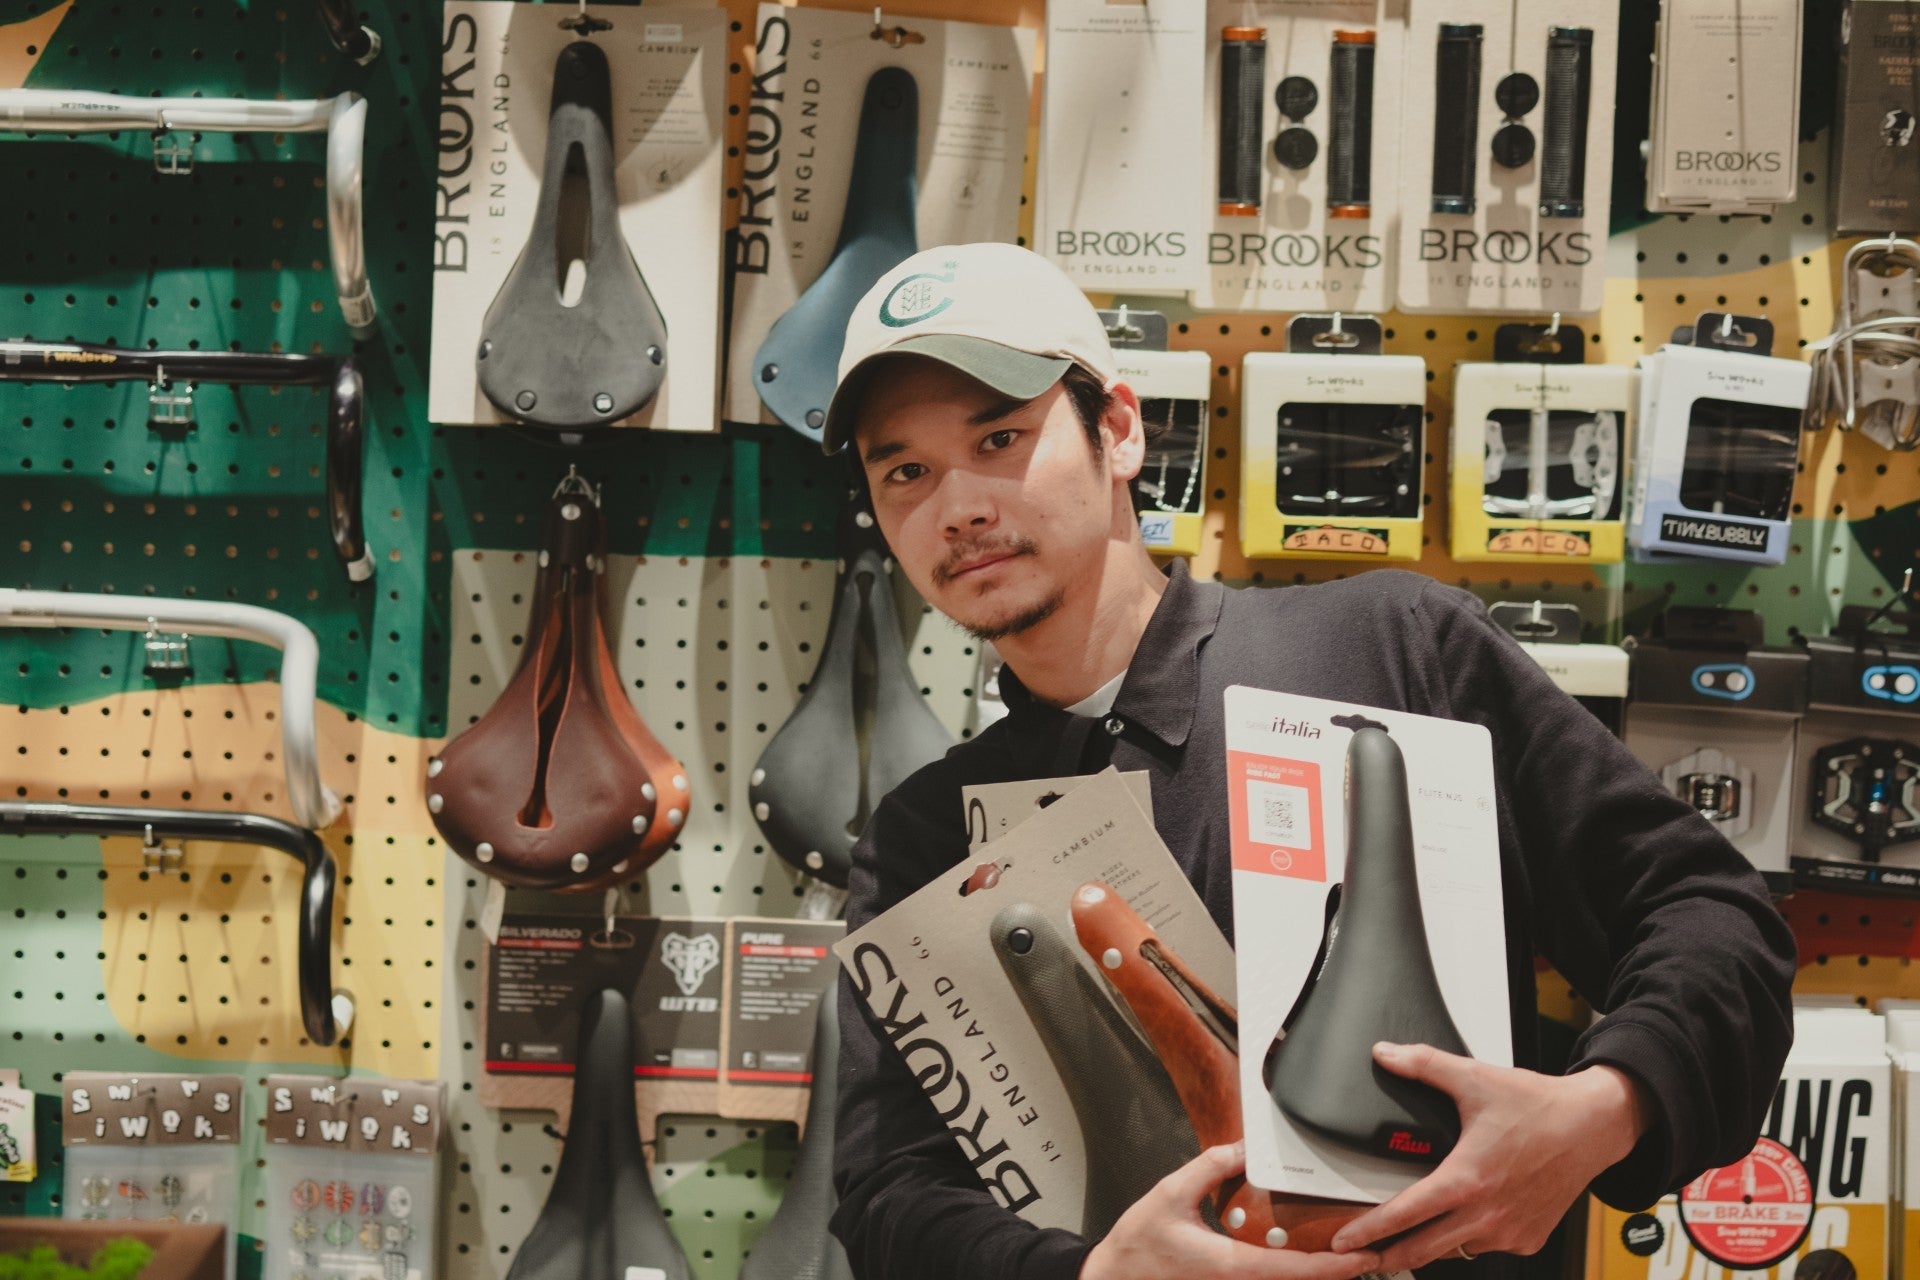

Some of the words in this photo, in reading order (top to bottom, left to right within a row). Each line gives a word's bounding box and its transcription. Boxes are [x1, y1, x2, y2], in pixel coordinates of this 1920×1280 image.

[433, 13, 477, 273] BROOKS
[490, 73, 510, 217] ENGLAND
[735, 16, 790, 275] BROOKS
[792, 77, 821, 222] ENGLAND
[1676, 151, 1781, 172] BROOKS
[1056, 231, 1187, 257] BROOKS
[1208, 233, 1382, 268] BROOKS
[1419, 229, 1592, 265] BROOKS
[1084, 264, 1157, 274] ENGLAND
[1243, 279, 1342, 291] ENGLAND
[1455, 275, 1552, 289] ENGLAND
[1663, 519, 1706, 539] TINY
[1295, 533, 1375, 550] TACO
[1272, 717, 1321, 739] italia
[1052, 820, 1115, 864] CAMBIUM
[500, 926, 582, 939] SILVERADO
[741, 932, 785, 945] PURE
[910, 936, 930, 960] 66
[934, 974, 1039, 1129] ENGLAND
[852, 942, 1042, 1213] BROOKS
[1041, 1140, 1061, 1162] 18
[1715, 1206, 1779, 1220] BRAKE
